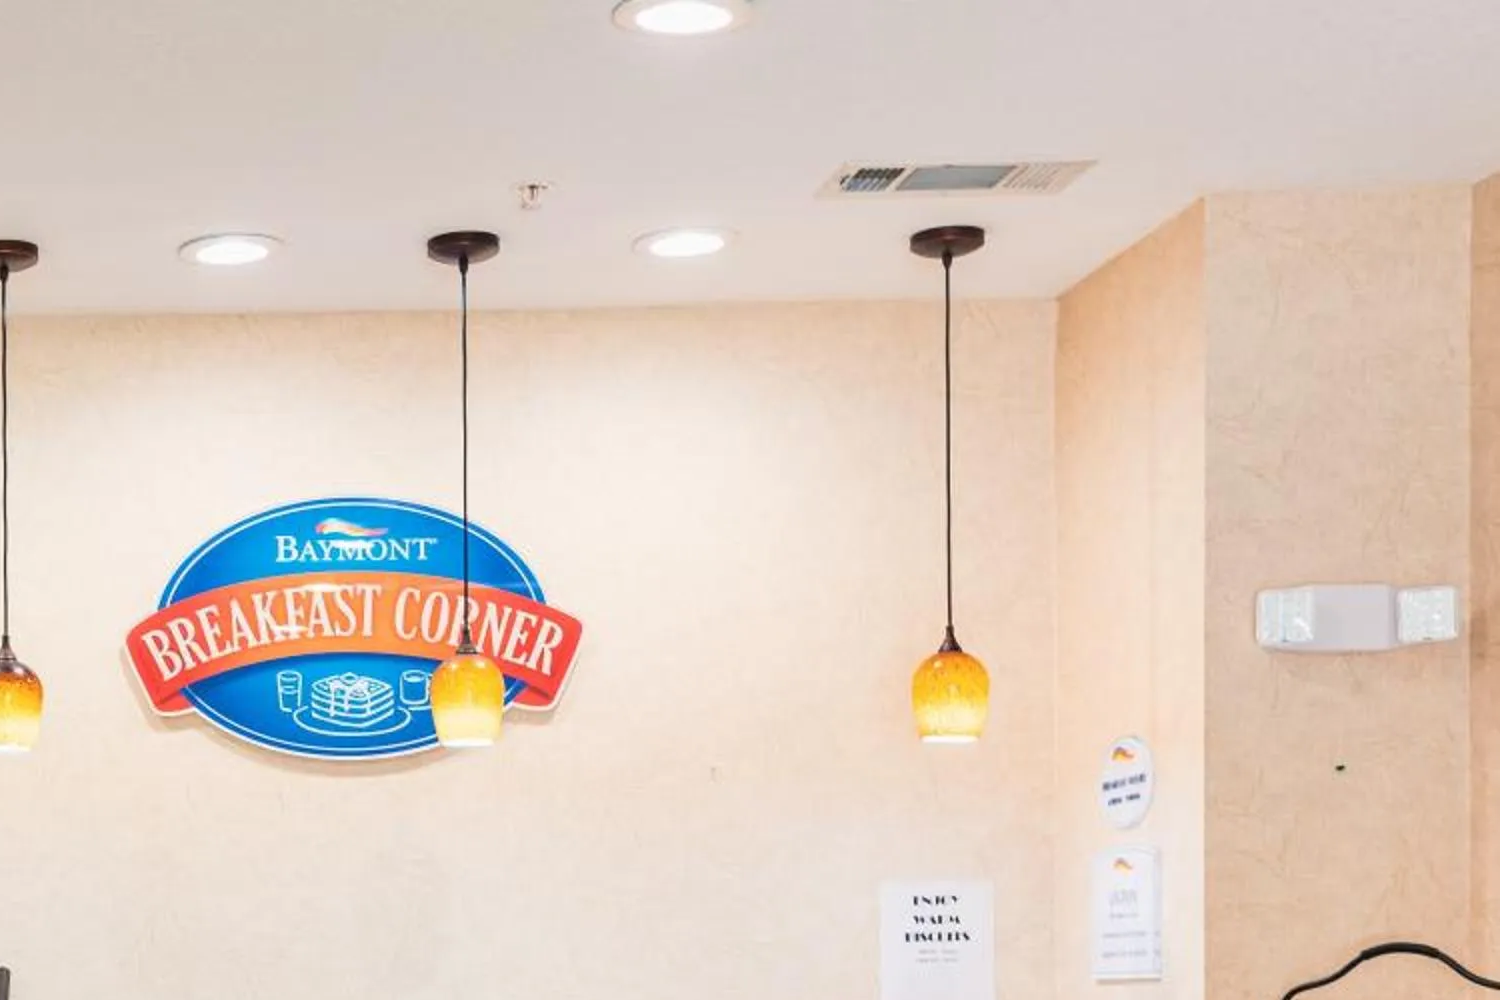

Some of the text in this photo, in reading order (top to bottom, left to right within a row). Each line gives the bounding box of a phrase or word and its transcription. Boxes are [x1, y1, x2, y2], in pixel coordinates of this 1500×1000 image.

[275, 535, 434, 563] BAYMONT
[141, 583, 564, 681] BREAKFAST CORNER
